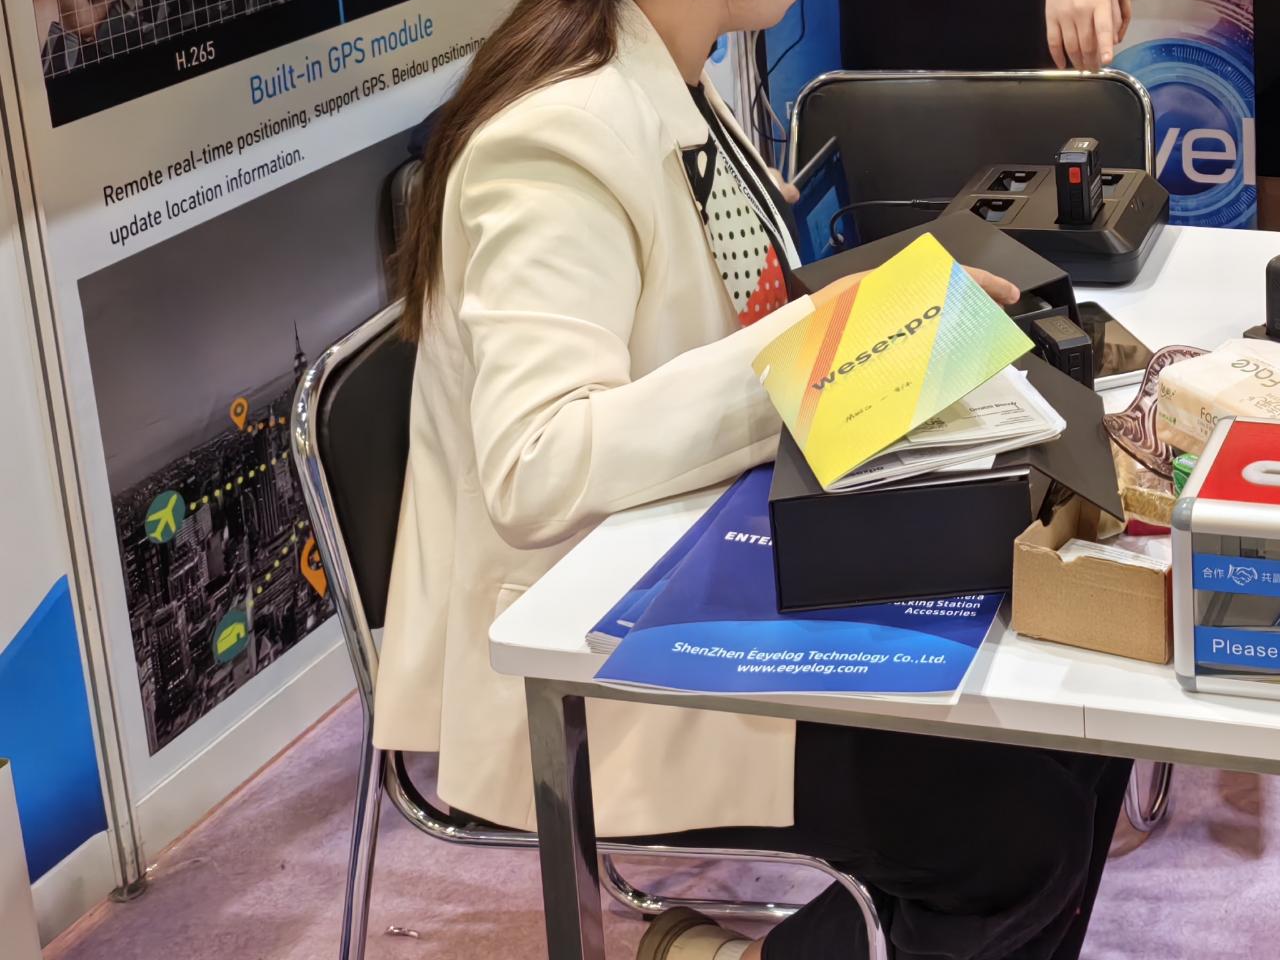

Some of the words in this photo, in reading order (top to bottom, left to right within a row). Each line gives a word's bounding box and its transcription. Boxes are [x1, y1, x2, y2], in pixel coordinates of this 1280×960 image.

[175, 40, 216, 72] H.265
[250, 54, 323, 105] Built-in
[328, 36, 366, 74] GPS
[371, 13, 434, 59] module
[103, 168, 163, 207] Remote
[167, 139, 234, 181] real-time
[237, 108, 312, 156] positioning,
[314, 87, 361, 118] support
[362, 73, 390, 98] GPS.
[392, 59, 429, 86] Beidou
[109, 210, 162, 247] update
[165, 181, 224, 220] location
[225, 147, 305, 193] information.
[812, 305, 942, 391] wesexpo
[1199, 406, 1218, 425] Fac
[724, 531, 773, 546] ENTE
[1202, 566, 1225, 579] 合作
[904, 607, 977, 617] Accessories
[936, 600, 982, 609] Station
[671, 641, 745, 660] ShenZhen
[808, 650, 890, 665] Technology
[893, 652, 947, 666] Co.,Ltd.
[1212, 639, 1278, 660] Please
[736, 662, 869, 675] www.eeyelog.com
